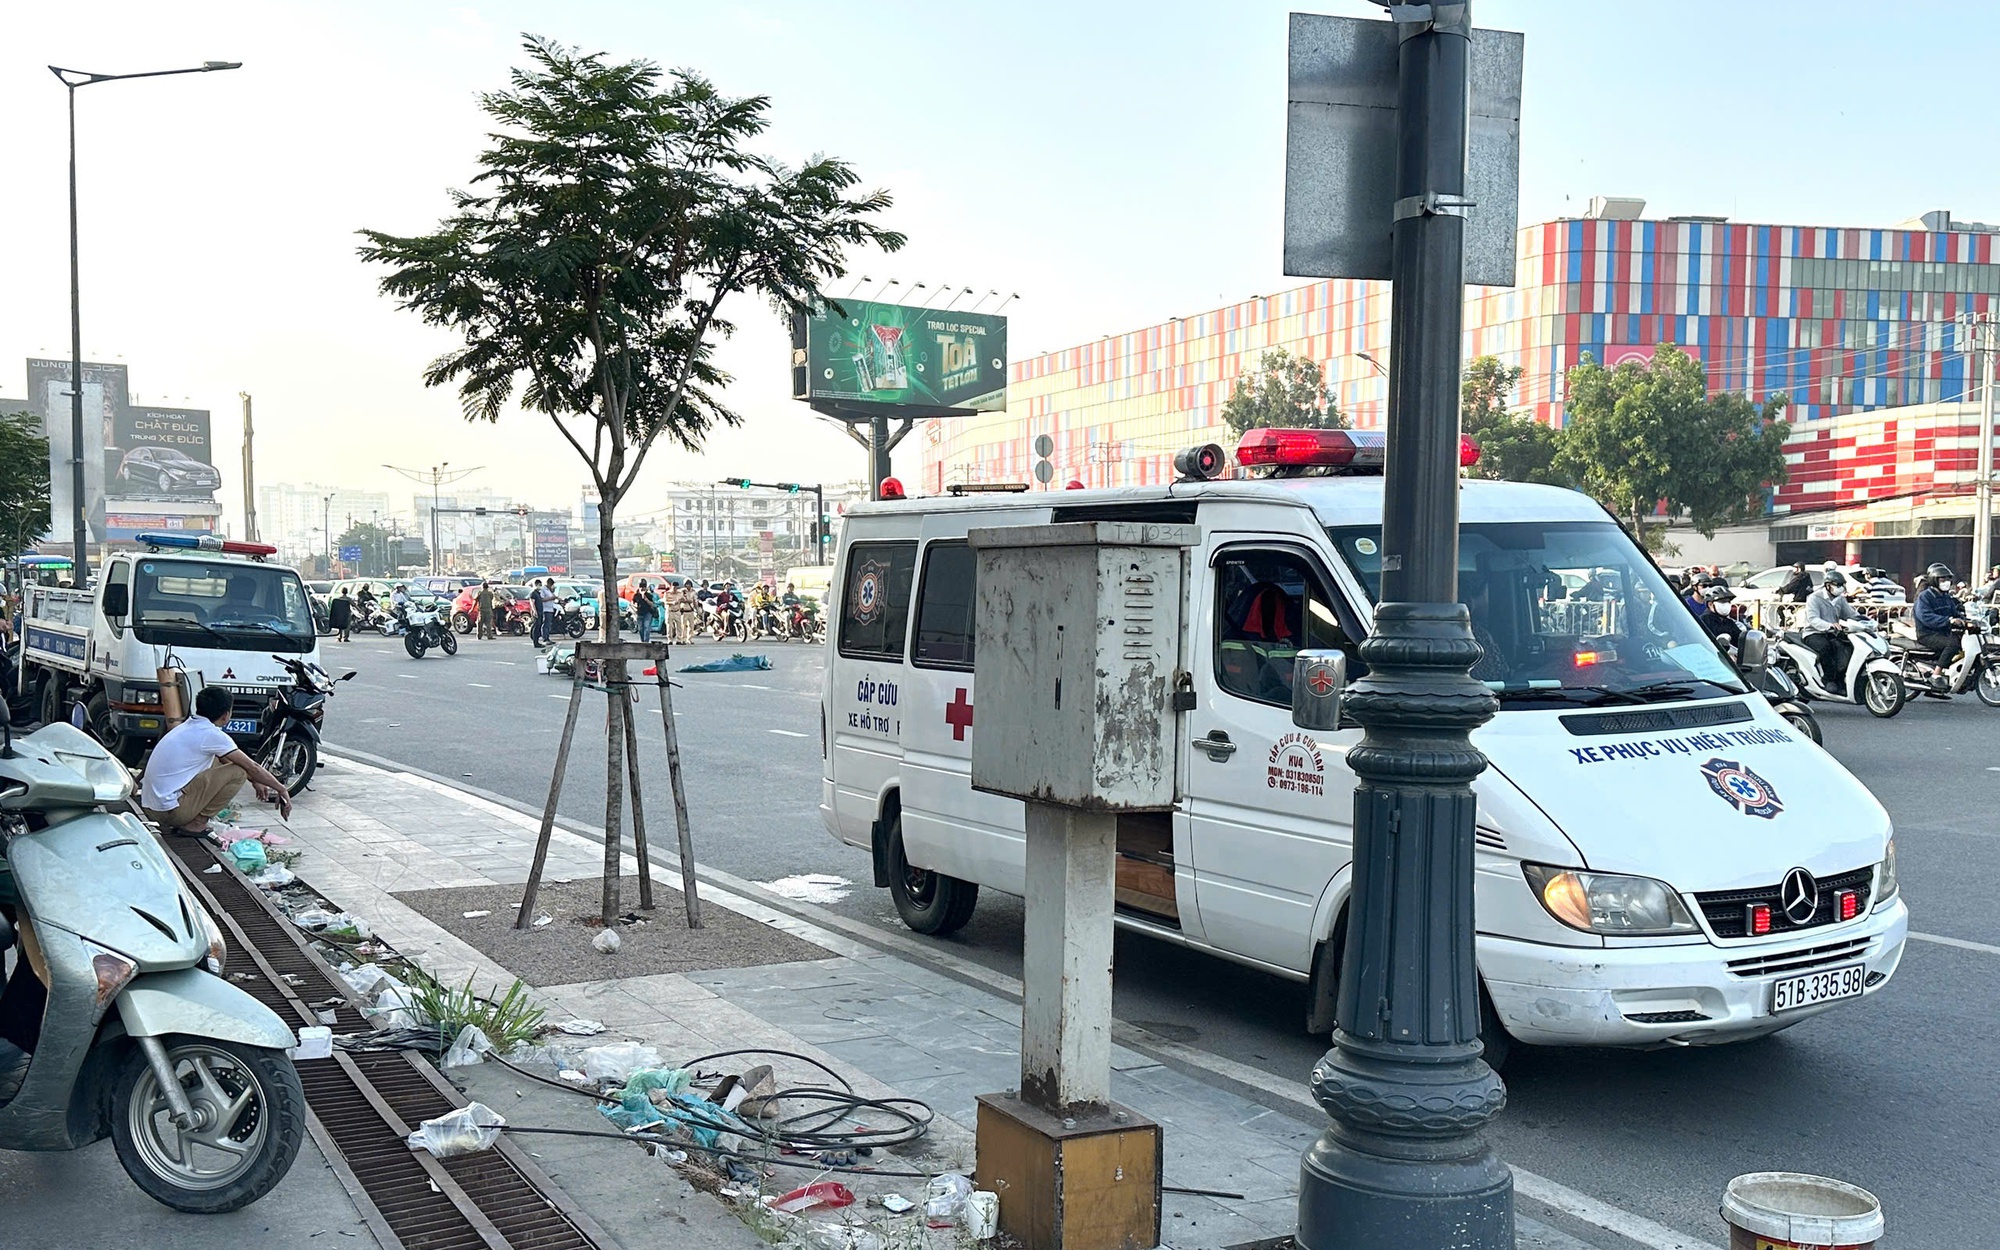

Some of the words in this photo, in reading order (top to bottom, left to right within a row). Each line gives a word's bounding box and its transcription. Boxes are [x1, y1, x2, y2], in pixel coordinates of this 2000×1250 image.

[927, 320, 945, 331] TRAO
[960, 324, 987, 336] SPECIAL
[158, 434, 175, 444] XE
[256, 675, 292, 683] CANTER
[857, 673, 876, 703] CẤP
[878, 679, 898, 706] CỨU
[226, 721, 251, 732] 4321
[848, 712, 858, 728] XE
[860, 708, 871, 730] HỖ
[873, 716, 890, 737] TRỢ
[1295, 732, 1302, 743] &
[1568, 747, 1605, 765] XE
[1599, 741, 1661, 760] PHỤC
[1655, 735, 1692, 756] VỤ
[1685, 731, 1735, 751] HIỆN
[1726, 725, 1795, 746] TRƯỜNG
[1288, 754, 1304, 769] KV4
[1776, 968, 1861, 1008] 51B-335.98
